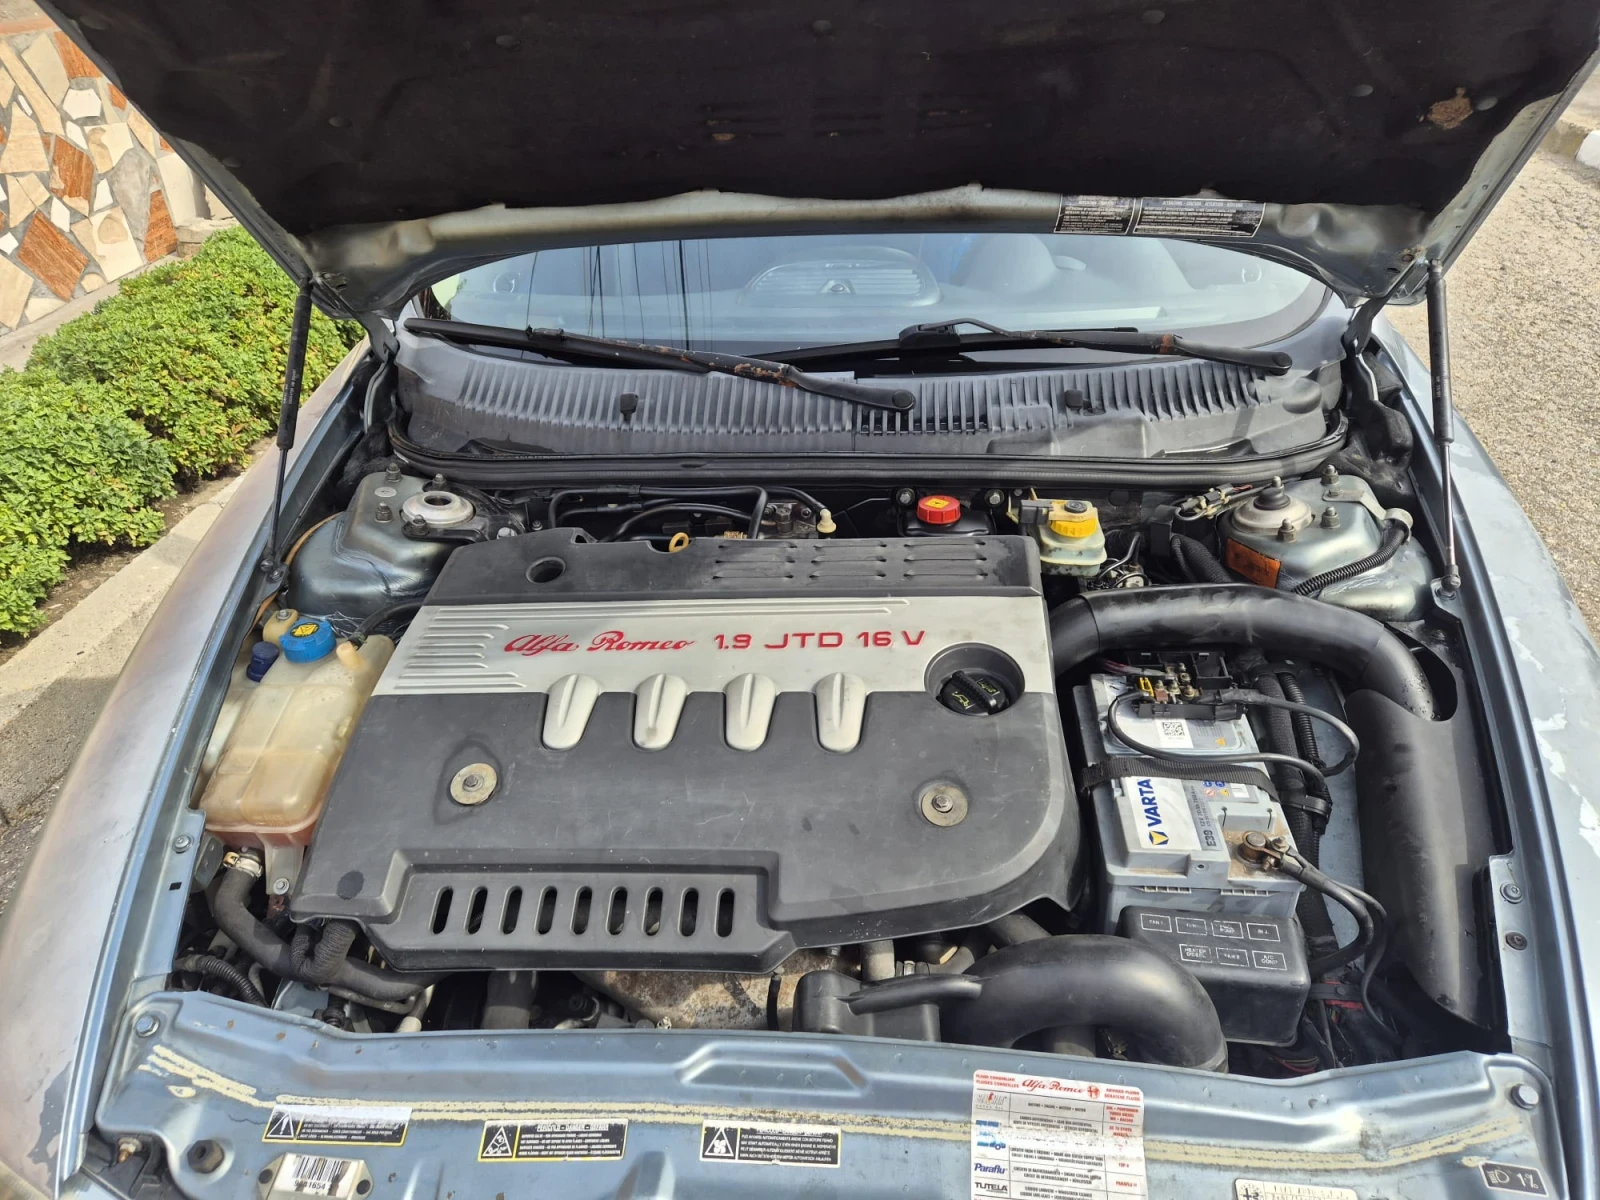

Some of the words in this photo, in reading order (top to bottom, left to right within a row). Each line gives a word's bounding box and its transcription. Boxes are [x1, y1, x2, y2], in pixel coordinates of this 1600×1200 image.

[504, 634, 580, 656] Alfa
[586, 630, 695, 652] Romeo
[713, 633, 752, 650] 1.9
[764, 631, 844, 649] JTD
[856, 631, 892, 648] 16
[901, 630, 926, 646] V
[1137, 778, 1163, 827] VARTA
[1203, 829, 1216, 847] E39
[1021, 1078, 1048, 1093] Alfa
[1049, 1080, 1086, 1094] Romeo
[974, 1162, 1006, 1174] Paraflu
[974, 1181, 1008, 1191] TUTELA
